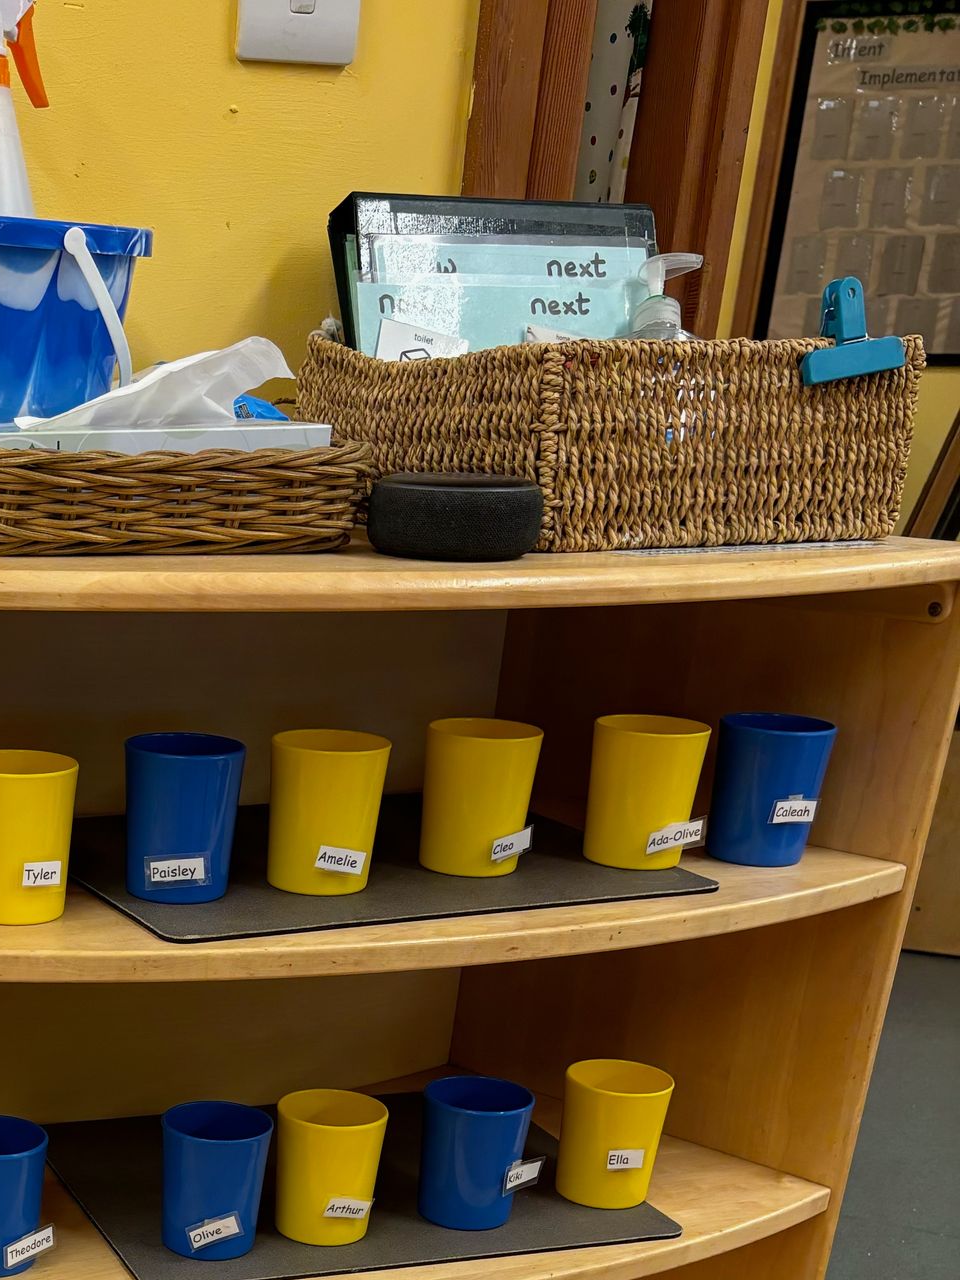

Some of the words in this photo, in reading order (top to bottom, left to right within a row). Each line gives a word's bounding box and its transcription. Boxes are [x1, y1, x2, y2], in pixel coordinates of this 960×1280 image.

[546, 252, 607, 280] next
[530, 291, 591, 317] next
[414, 333, 434, 346] toilet
[775, 806, 810, 818] Caleah
[648, 827, 701, 848] Ada-Olive
[492, 840, 514, 855] Cleo
[318, 851, 358, 869] Amelie
[25, 868, 57, 884] Tyler
[152, 865, 197, 880] Paisley
[608, 1154, 630, 1166] Ella
[326, 1202, 365, 1216] Arthur
[192, 1226, 223, 1244] Olive
[9, 1234, 52, 1260] Theodore
